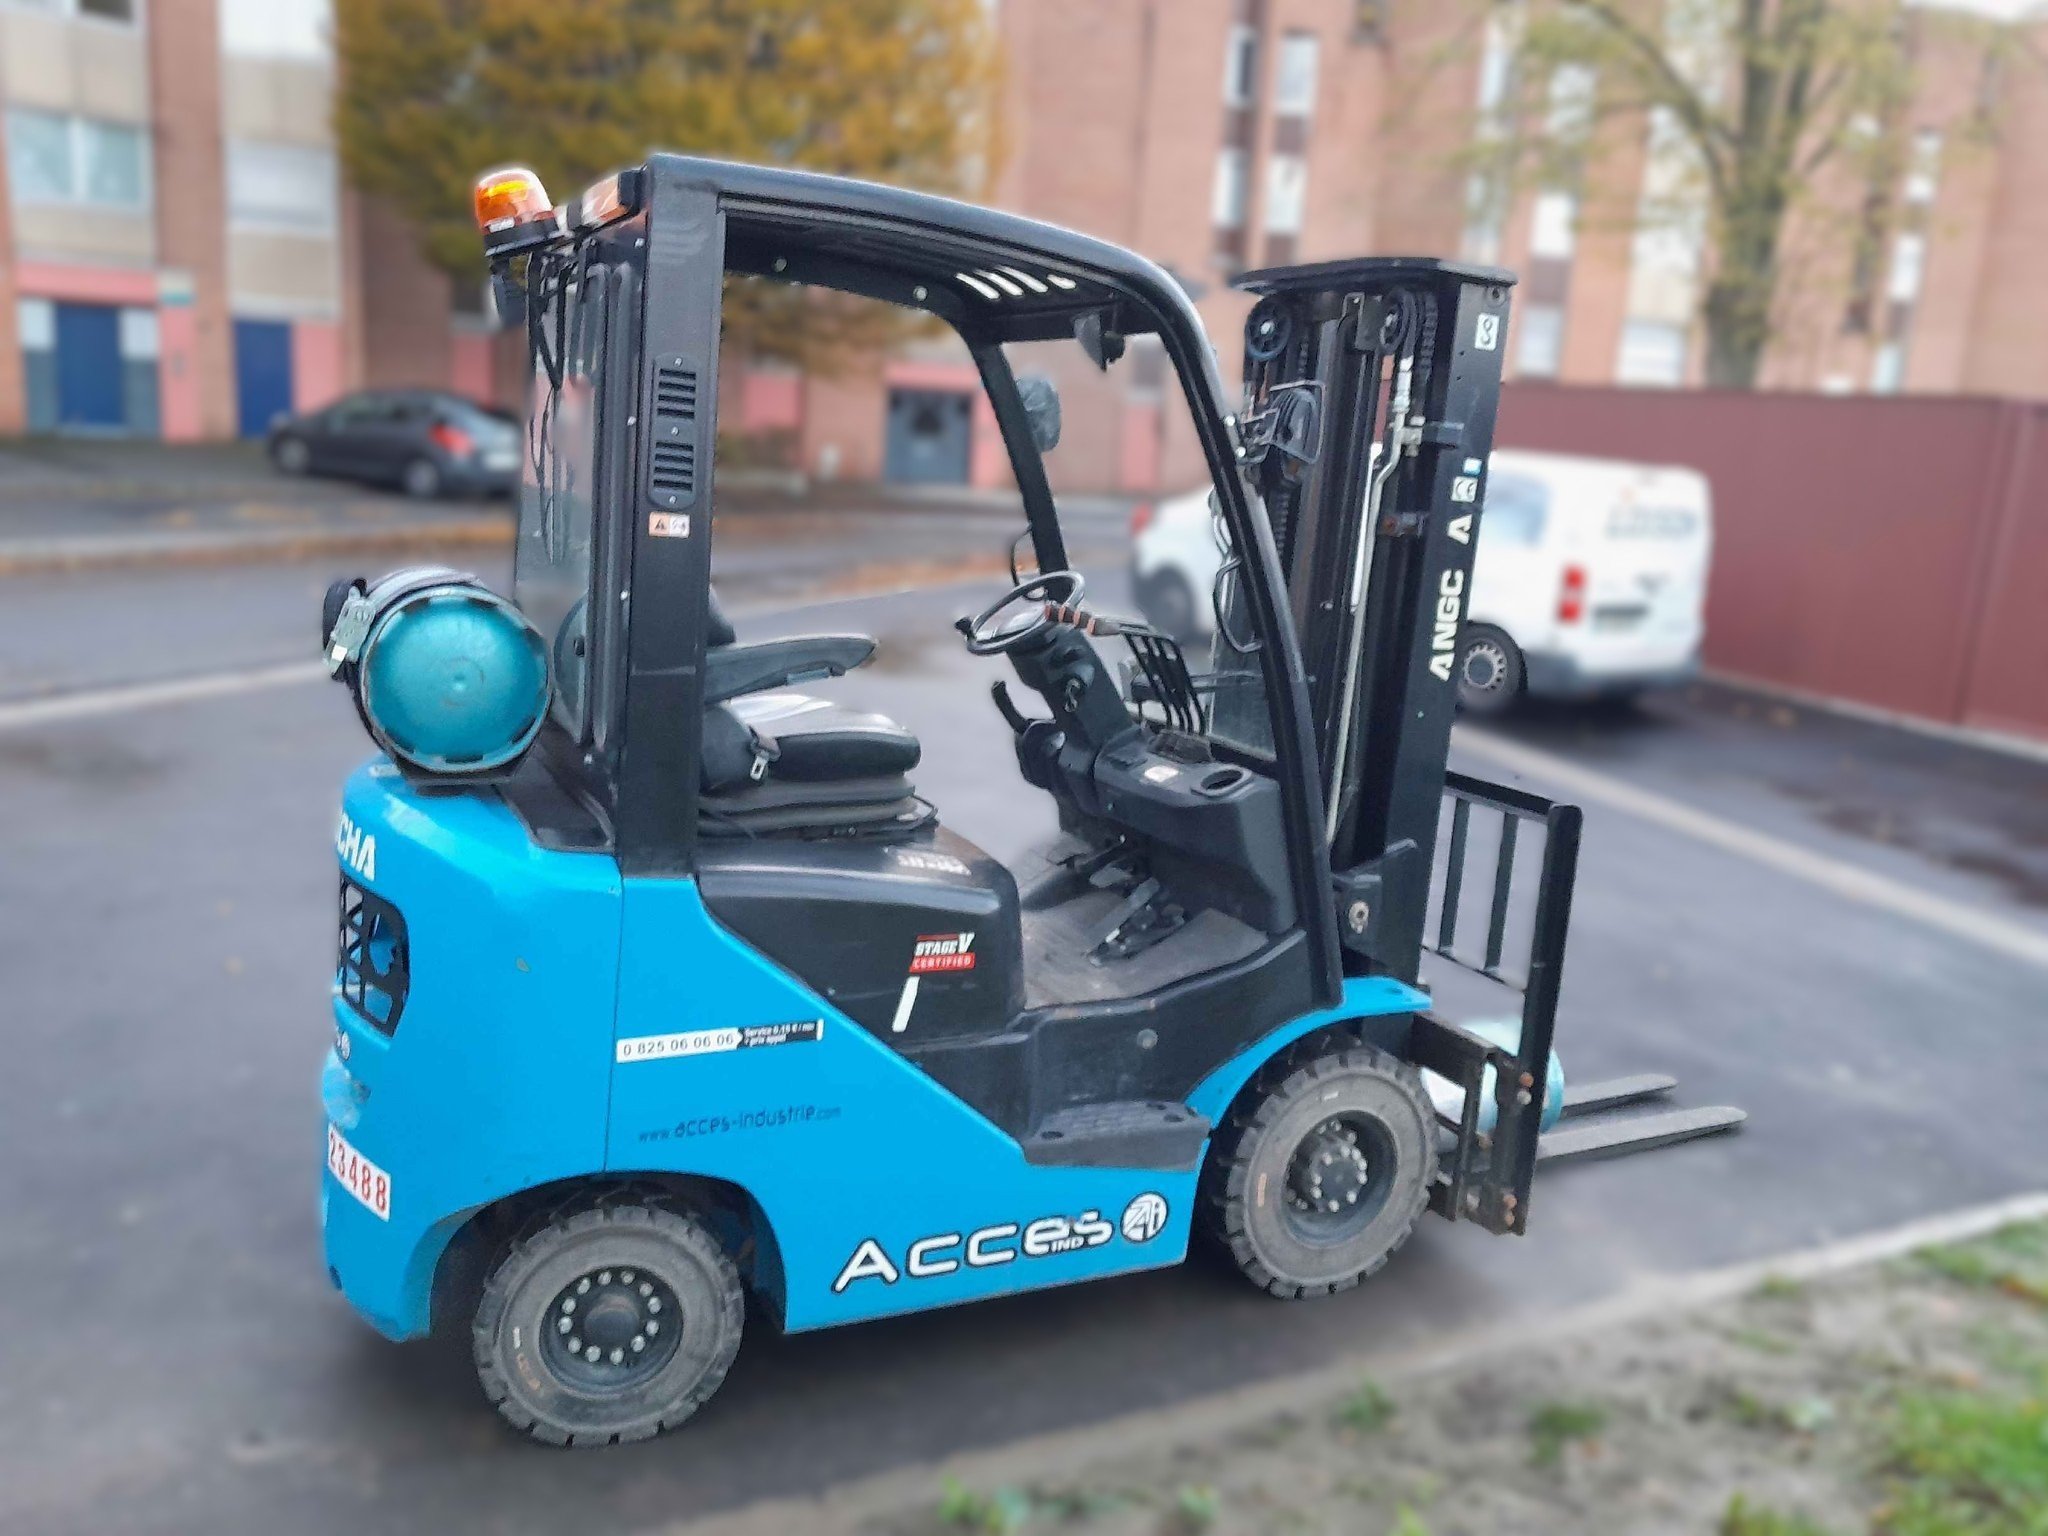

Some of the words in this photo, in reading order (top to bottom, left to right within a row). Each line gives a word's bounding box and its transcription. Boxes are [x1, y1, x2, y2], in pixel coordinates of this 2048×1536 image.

[914, 940, 958, 957] STAGE
[912, 955, 972, 969] CERTIFIED
[623, 1043, 632, 1057] 0
[637, 1041, 665, 1055] 825
[670, 1038, 688, 1052] 06
[693, 1035, 711, 1049] 06
[716, 1032, 735, 1046] 06
[328, 1131, 387, 1212] 23488
